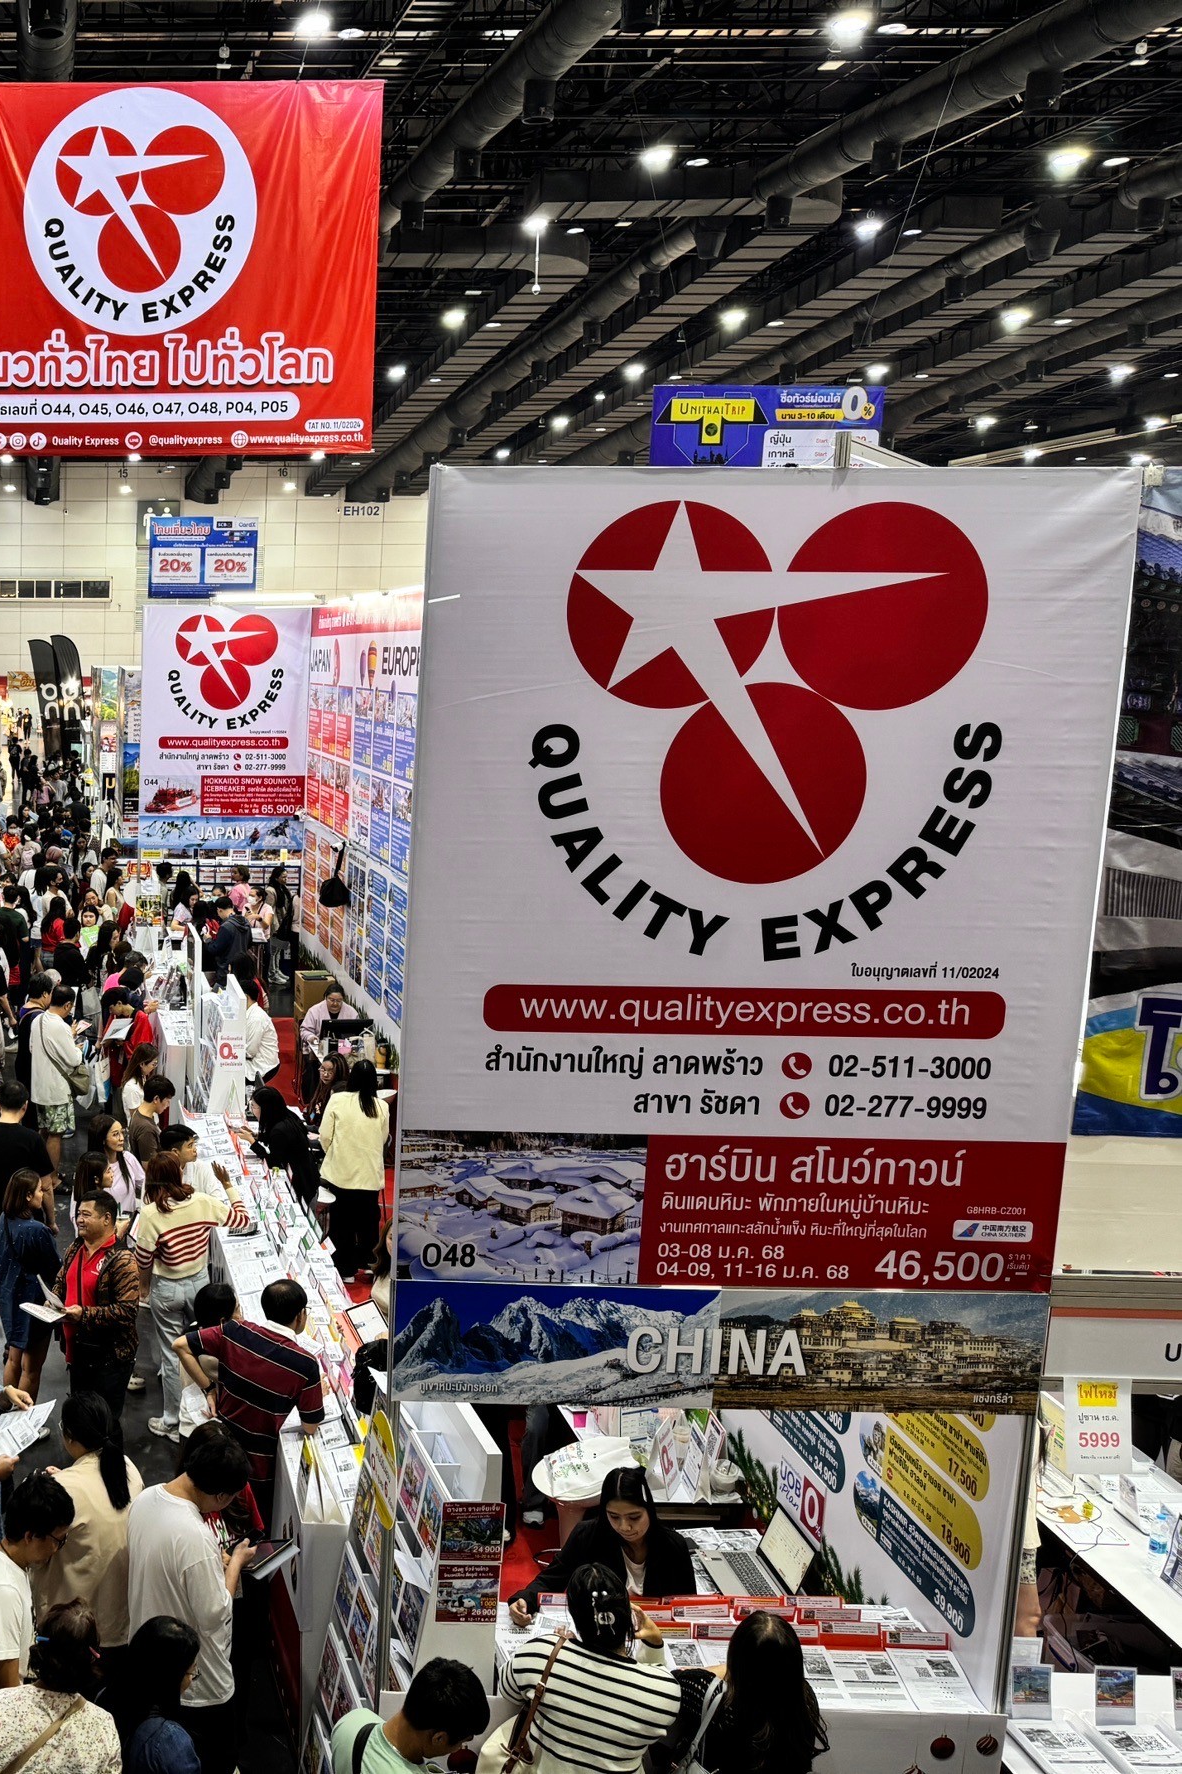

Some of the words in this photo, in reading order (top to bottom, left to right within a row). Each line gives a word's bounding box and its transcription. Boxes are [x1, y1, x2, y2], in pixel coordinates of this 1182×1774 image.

[44, 217, 129, 322] QUALITY
[143, 214, 235, 323] EXPRESS
[165, 328, 333, 384] ไปทั่วโลก
[261, 401, 288, 413] P05
[52, 436, 83, 447] Quality
[85, 436, 119, 447] Express
[149, 435, 223, 446] @qualityexpress
[250, 433, 364, 445] www.qualityexpress.co.th
[769, 431, 792, 445] ญี่ปุ่น
[768, 448, 795, 458] เกาหลี
[117, 469, 128, 478] 15
[277, 468, 288, 477] 16
[343, 506, 380, 516] EH102
[159, 559, 192, 573] 20%
[213, 559, 247, 573] 20%
[310, 649, 331, 673] JAPAN
[167, 669, 219, 729] QUALITY
[226, 668, 284, 730] EXPRESS
[167, 737, 281, 748] www.qualityexpress.co.th
[245, 753, 286, 761] 02-511-3000
[245, 763, 286, 771] 02-277-9999
[197, 827, 245, 840] JAPAN
[527, 723, 730, 956] QUALITY
[761, 720, 1003, 962] EXPRESS
[851, 961, 938, 981] ใบอนุญาตเลขที่
[941, 965, 1000, 979] 11/02024
[520, 993, 970, 1030] www.qualityexpress.co.th
[485, 1045, 645, 1079] สำนักงานใหญ่
[652, 1046, 764, 1077] ลาดพร้าว
[829, 1054, 992, 1080] 02-511-3000
[633, 1091, 691, 1115] สาขา
[699, 1089, 760, 1116] รัชดา
[824, 1095, 988, 1120] 02-277-9999
[665, 1146, 776, 1184] ฮาร์บิน
[790, 1146, 967, 1187] สโนว์ทาวน์
[661, 1191, 752, 1211] ดินแดนหิมะ
[759, 1192, 929, 1220] พักภายในหมู่บ้านหิมะ
[809, 1219, 927, 1241] หิมะที่ใหญ่ที่สุดในโลก
[982, 1224, 1027, 1233] 中国南方航空
[657, 1243, 711, 1259] 03-08
[719, 1245, 754, 1260] ม.ค.
[762, 1245, 785, 1260] 68
[656, 1262, 715, 1280] 04-09,
[723, 1263, 776, 1277] 11-16
[783, 1265, 818, 1279] ม.ค.
[826, 1265, 849, 1280] 68
[627, 1326, 807, 1377] CHINA
[419, 1380, 498, 1394] ภูเขาหิมะมังกรหยก
[1077, 1384, 1119, 1399] ไฟไหม้
[1078, 1412, 1100, 1424] ปูซาน
[1079, 1432, 1120, 1448] 5999
[780, 1460, 802, 1498] UOB
[813, 1455, 837, 1490] 34,900
[948, 1457, 978, 1497] 17,500
[883, 1496, 908, 1529] KASHMIR
[941, 1523, 971, 1565] 18,900
[933, 1588, 964, 1633] 39,900
